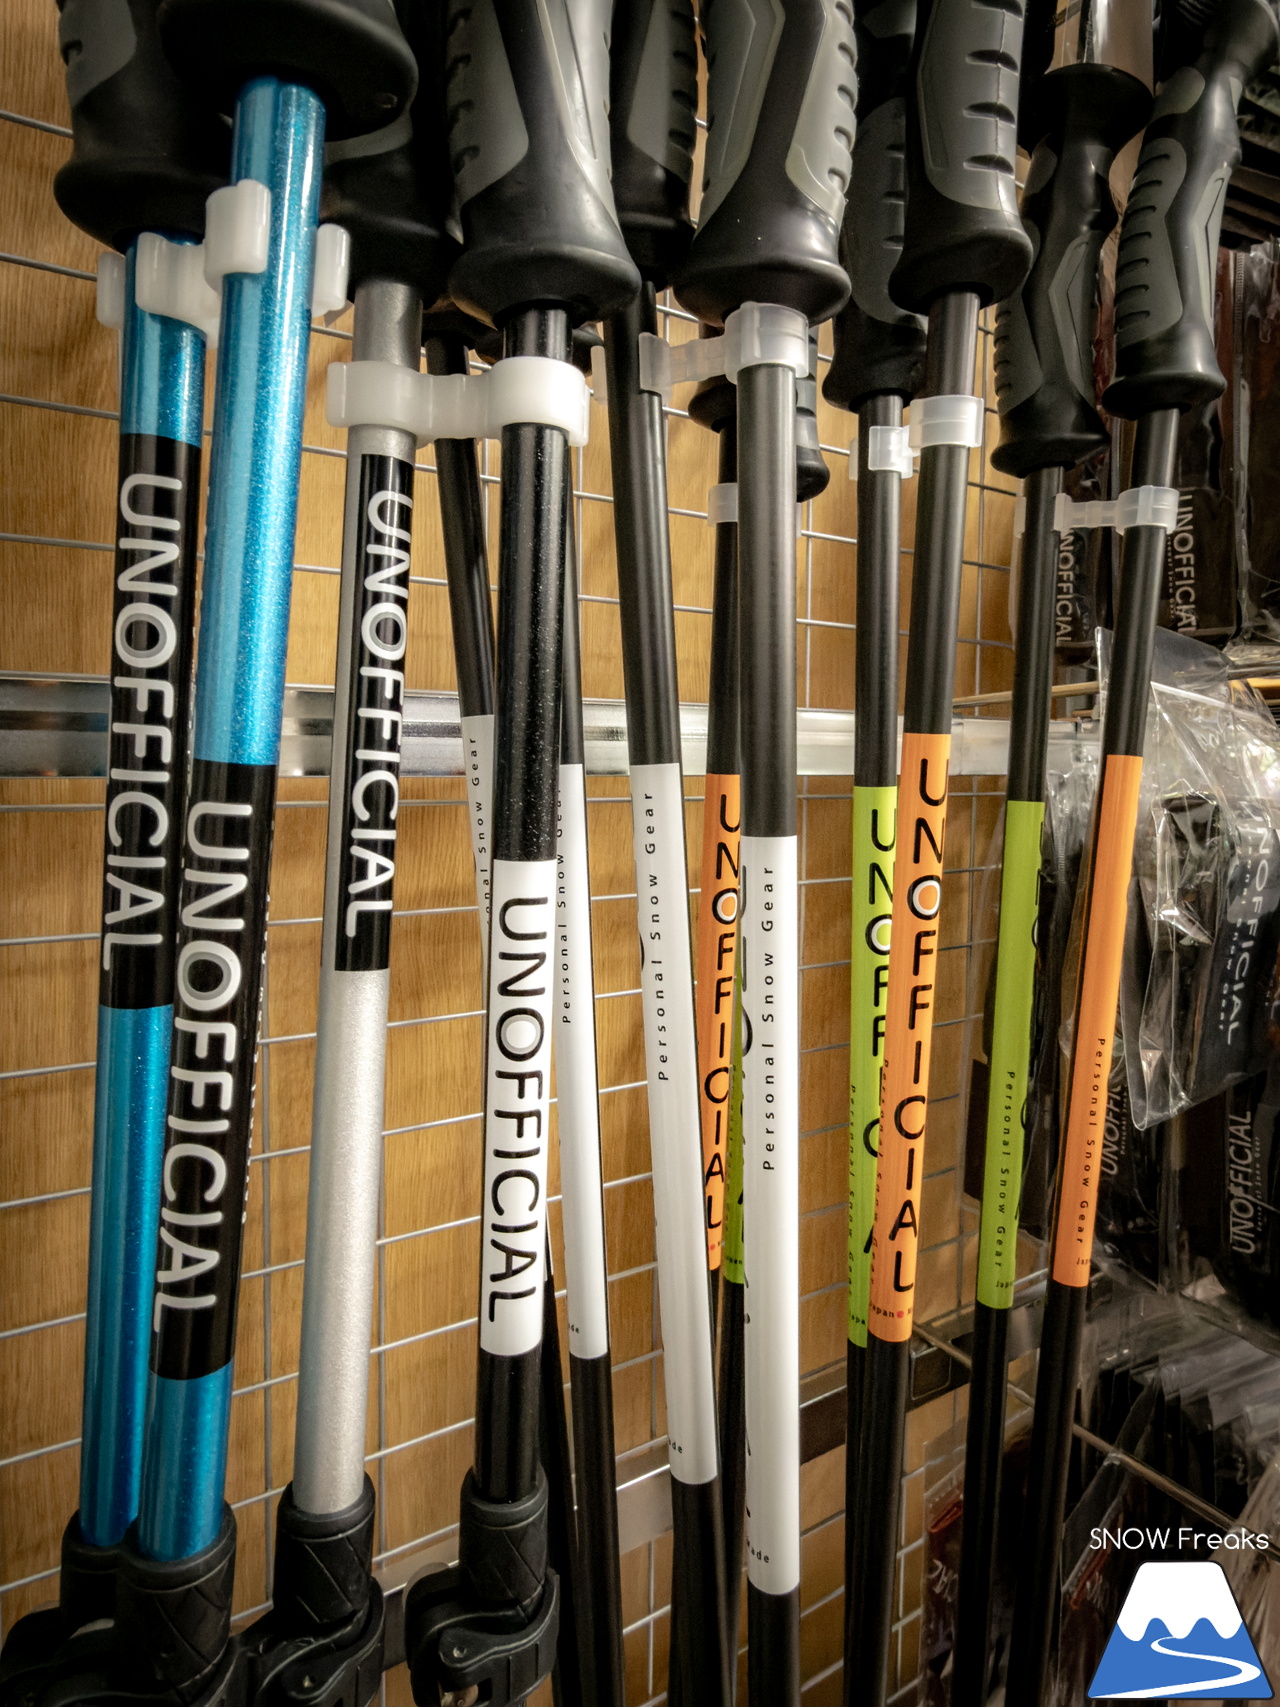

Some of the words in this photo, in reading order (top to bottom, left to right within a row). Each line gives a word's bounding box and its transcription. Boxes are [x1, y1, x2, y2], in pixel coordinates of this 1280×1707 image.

[103, 473, 183, 971] UNOFFICIAL
[345, 489, 413, 938] UNOFFICIAL
[470, 738, 480, 787] Gear
[476, 801, 487, 854] Snow
[644, 793, 656, 855] Gear
[649, 874, 661, 940] Snow
[761, 868, 774, 932] Gear
[558, 924, 572, 1024] Personal
[762, 953, 774, 1023] Snow
[651, 960, 669, 1081] Personal
[888, 758, 949, 1293] UNOFFICIAL
[154, 802, 253, 1333] UNOFFICIAL
[1088, 1038, 1106, 1126] Personal
[489, 897, 549, 1323] UNOFFICIAL
[761, 1043, 775, 1170] Personal
[1002, 1071, 1016, 1155] Personal
[999, 1167, 1010, 1214] Snow
[1082, 1139, 1095, 1187] Snow
[995, 1226, 1006, 1267] Gear
[1076, 1201, 1089, 1243] Gear
